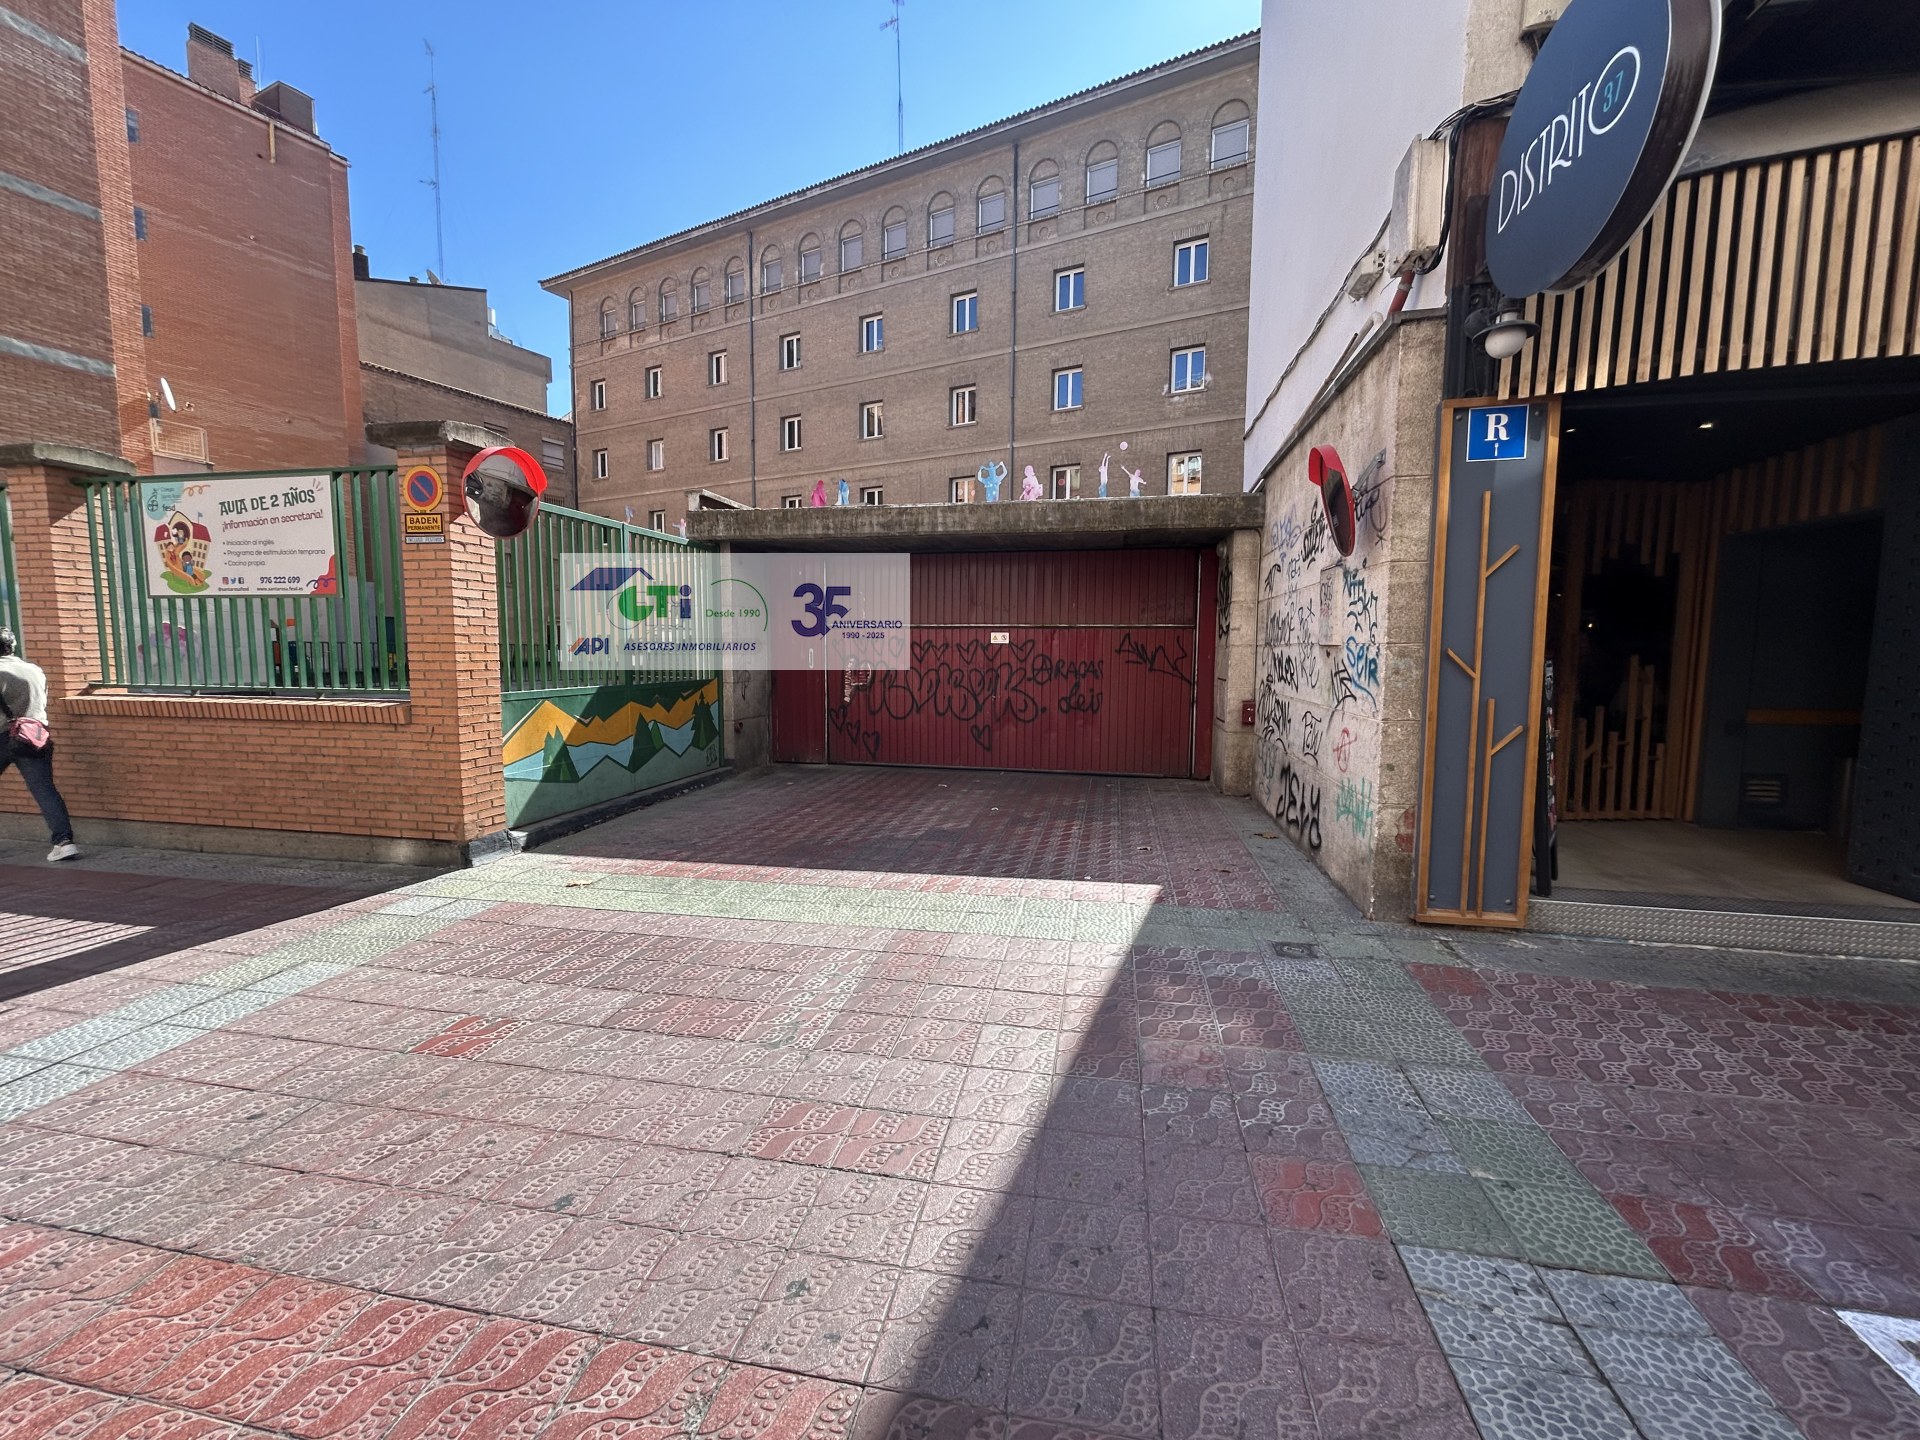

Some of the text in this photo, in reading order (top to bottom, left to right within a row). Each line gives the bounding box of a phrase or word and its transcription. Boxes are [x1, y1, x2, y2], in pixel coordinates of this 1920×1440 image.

[1602, 70, 1624, 113] 37
[1497, 45, 1641, 234] DISTRITO
[1484, 413, 1510, 441] R
[219, 487, 316, 516] AULA DE 2 AÑOS
[270, 517, 280, 525] en
[227, 549, 254, 558] Programa
[262, 548, 297, 556] estimulación
[297, 548, 326, 557] temprana
[247, 560, 266, 568] propia
[259, 576, 301, 584] 976 222 699
